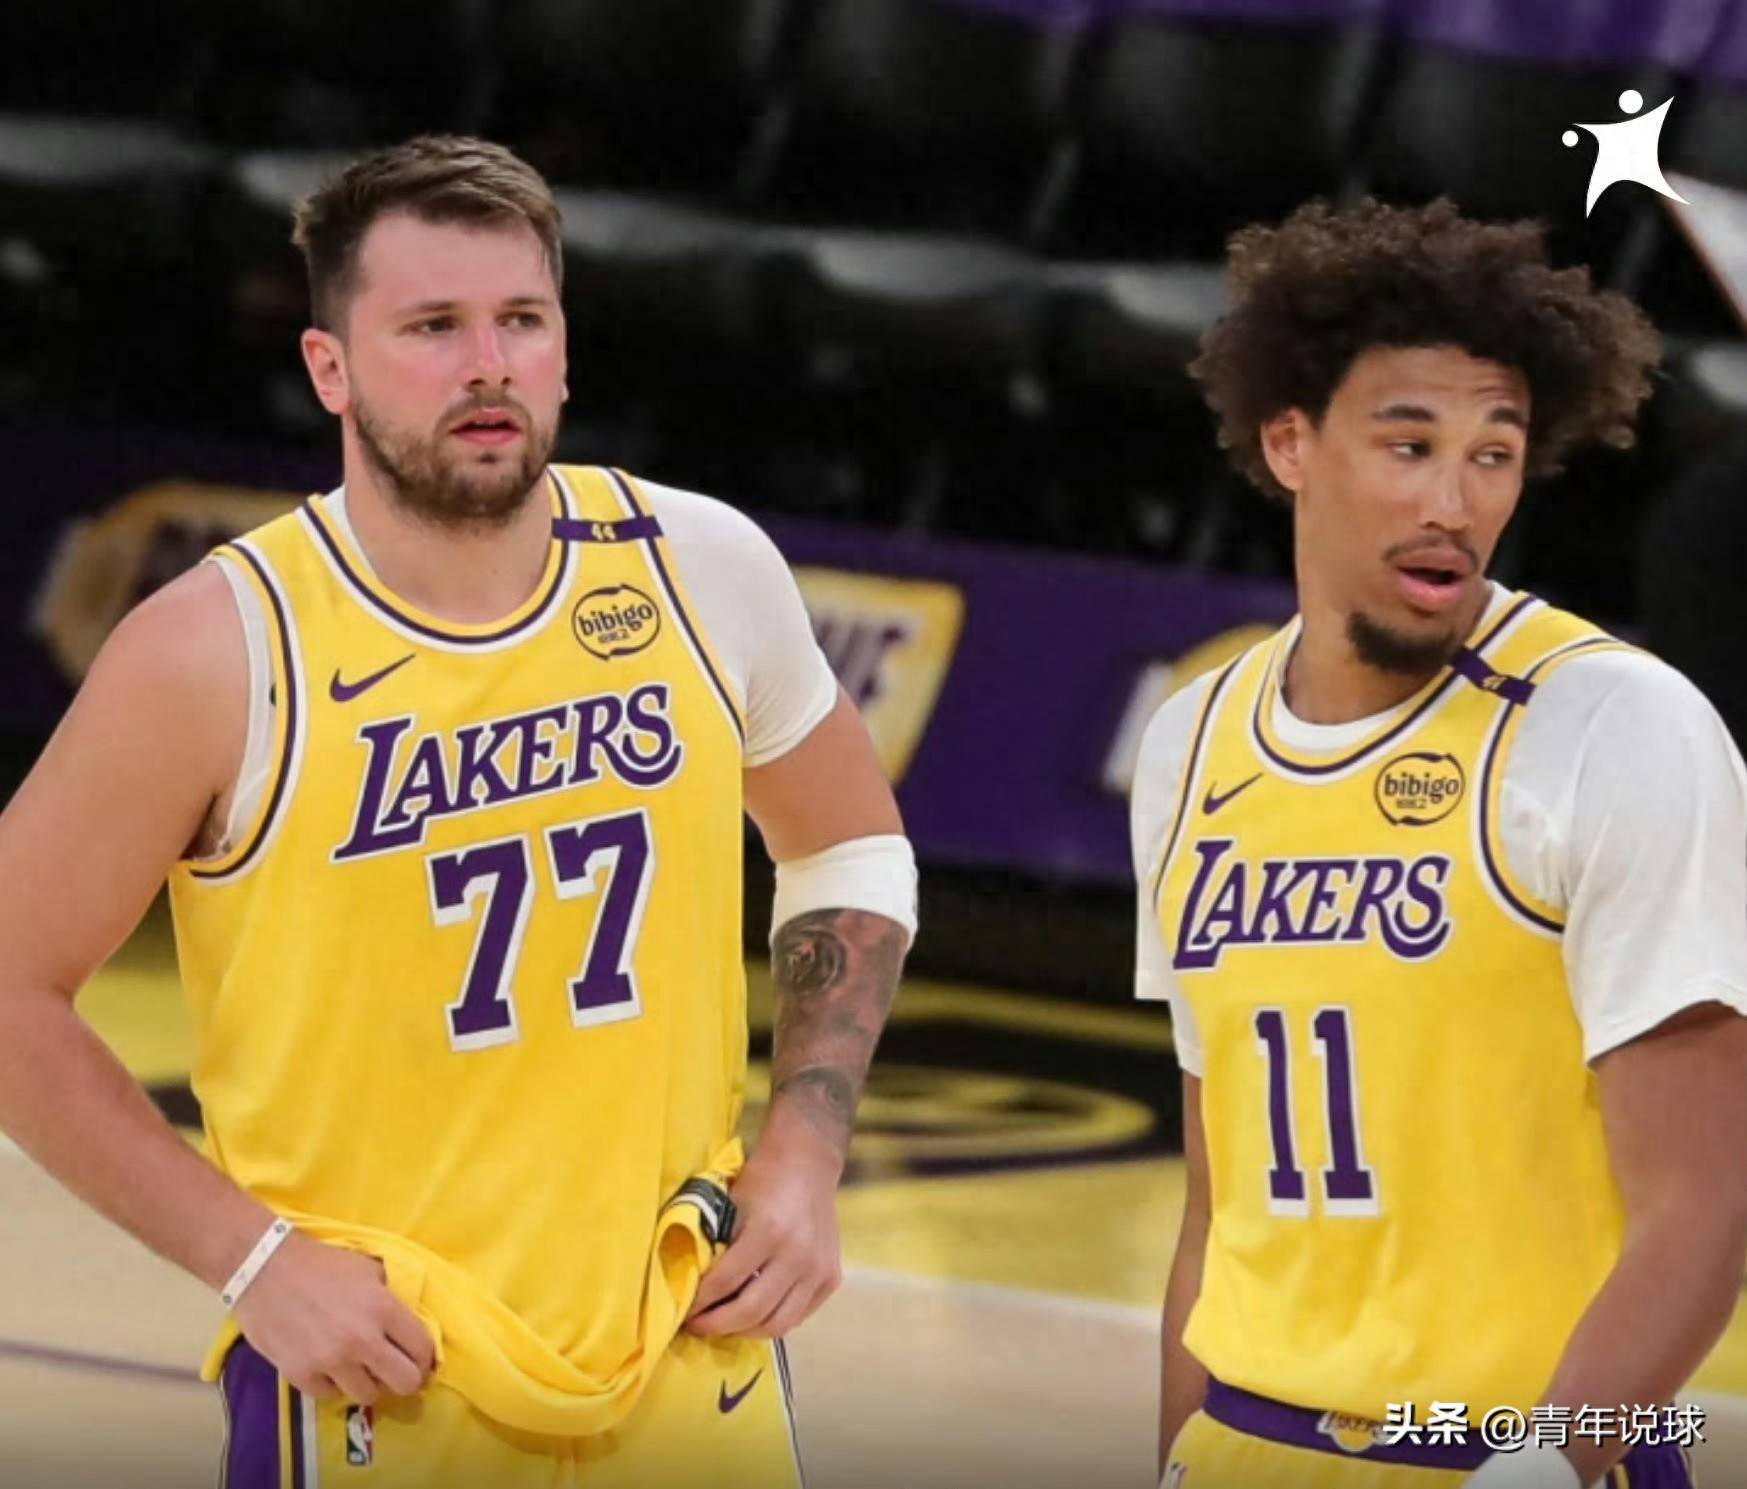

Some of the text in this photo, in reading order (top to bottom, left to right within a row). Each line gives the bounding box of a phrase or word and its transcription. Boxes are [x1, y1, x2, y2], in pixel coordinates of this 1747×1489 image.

[578, 604, 653, 635] bibigo
[334, 683, 683, 861] LAKERS
[1384, 771, 1459, 804] bibigo
[425, 807, 655, 1052] 77
[1173, 839, 1451, 970] LAKERS
[1254, 1005, 1380, 1216] 11
